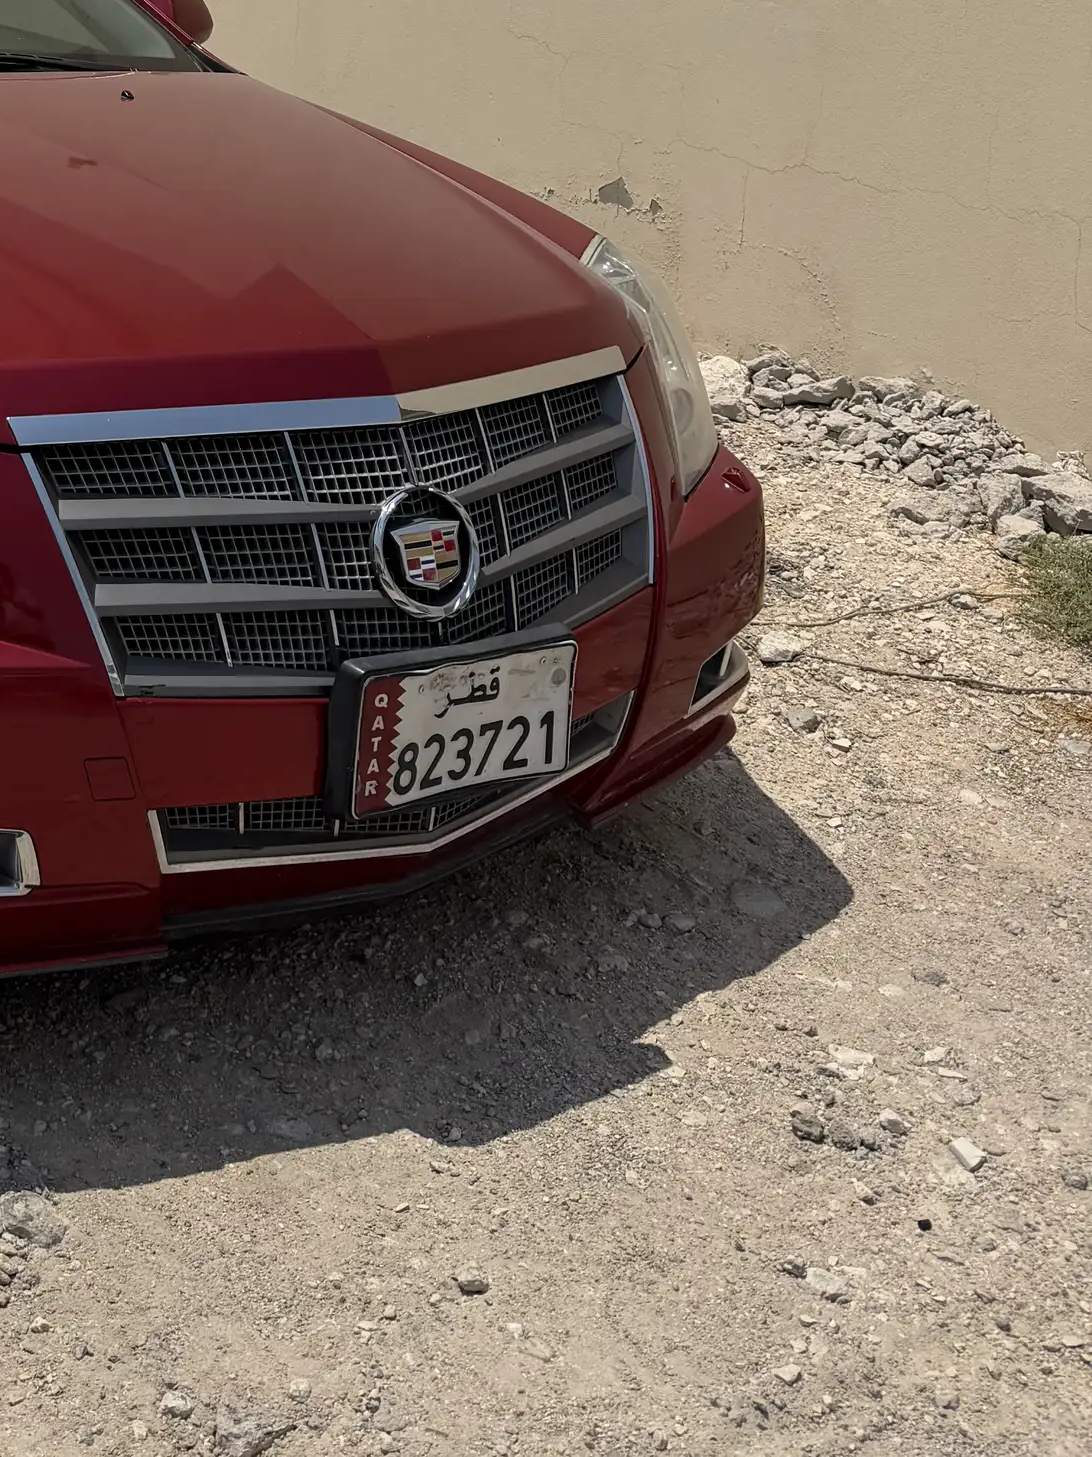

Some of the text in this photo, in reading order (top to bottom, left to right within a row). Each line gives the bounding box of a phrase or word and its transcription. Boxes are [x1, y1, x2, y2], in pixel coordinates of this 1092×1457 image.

[433, 665, 501, 719] قطر
[364, 693, 389, 796] QATAR
[393, 710, 554, 796] 823721
